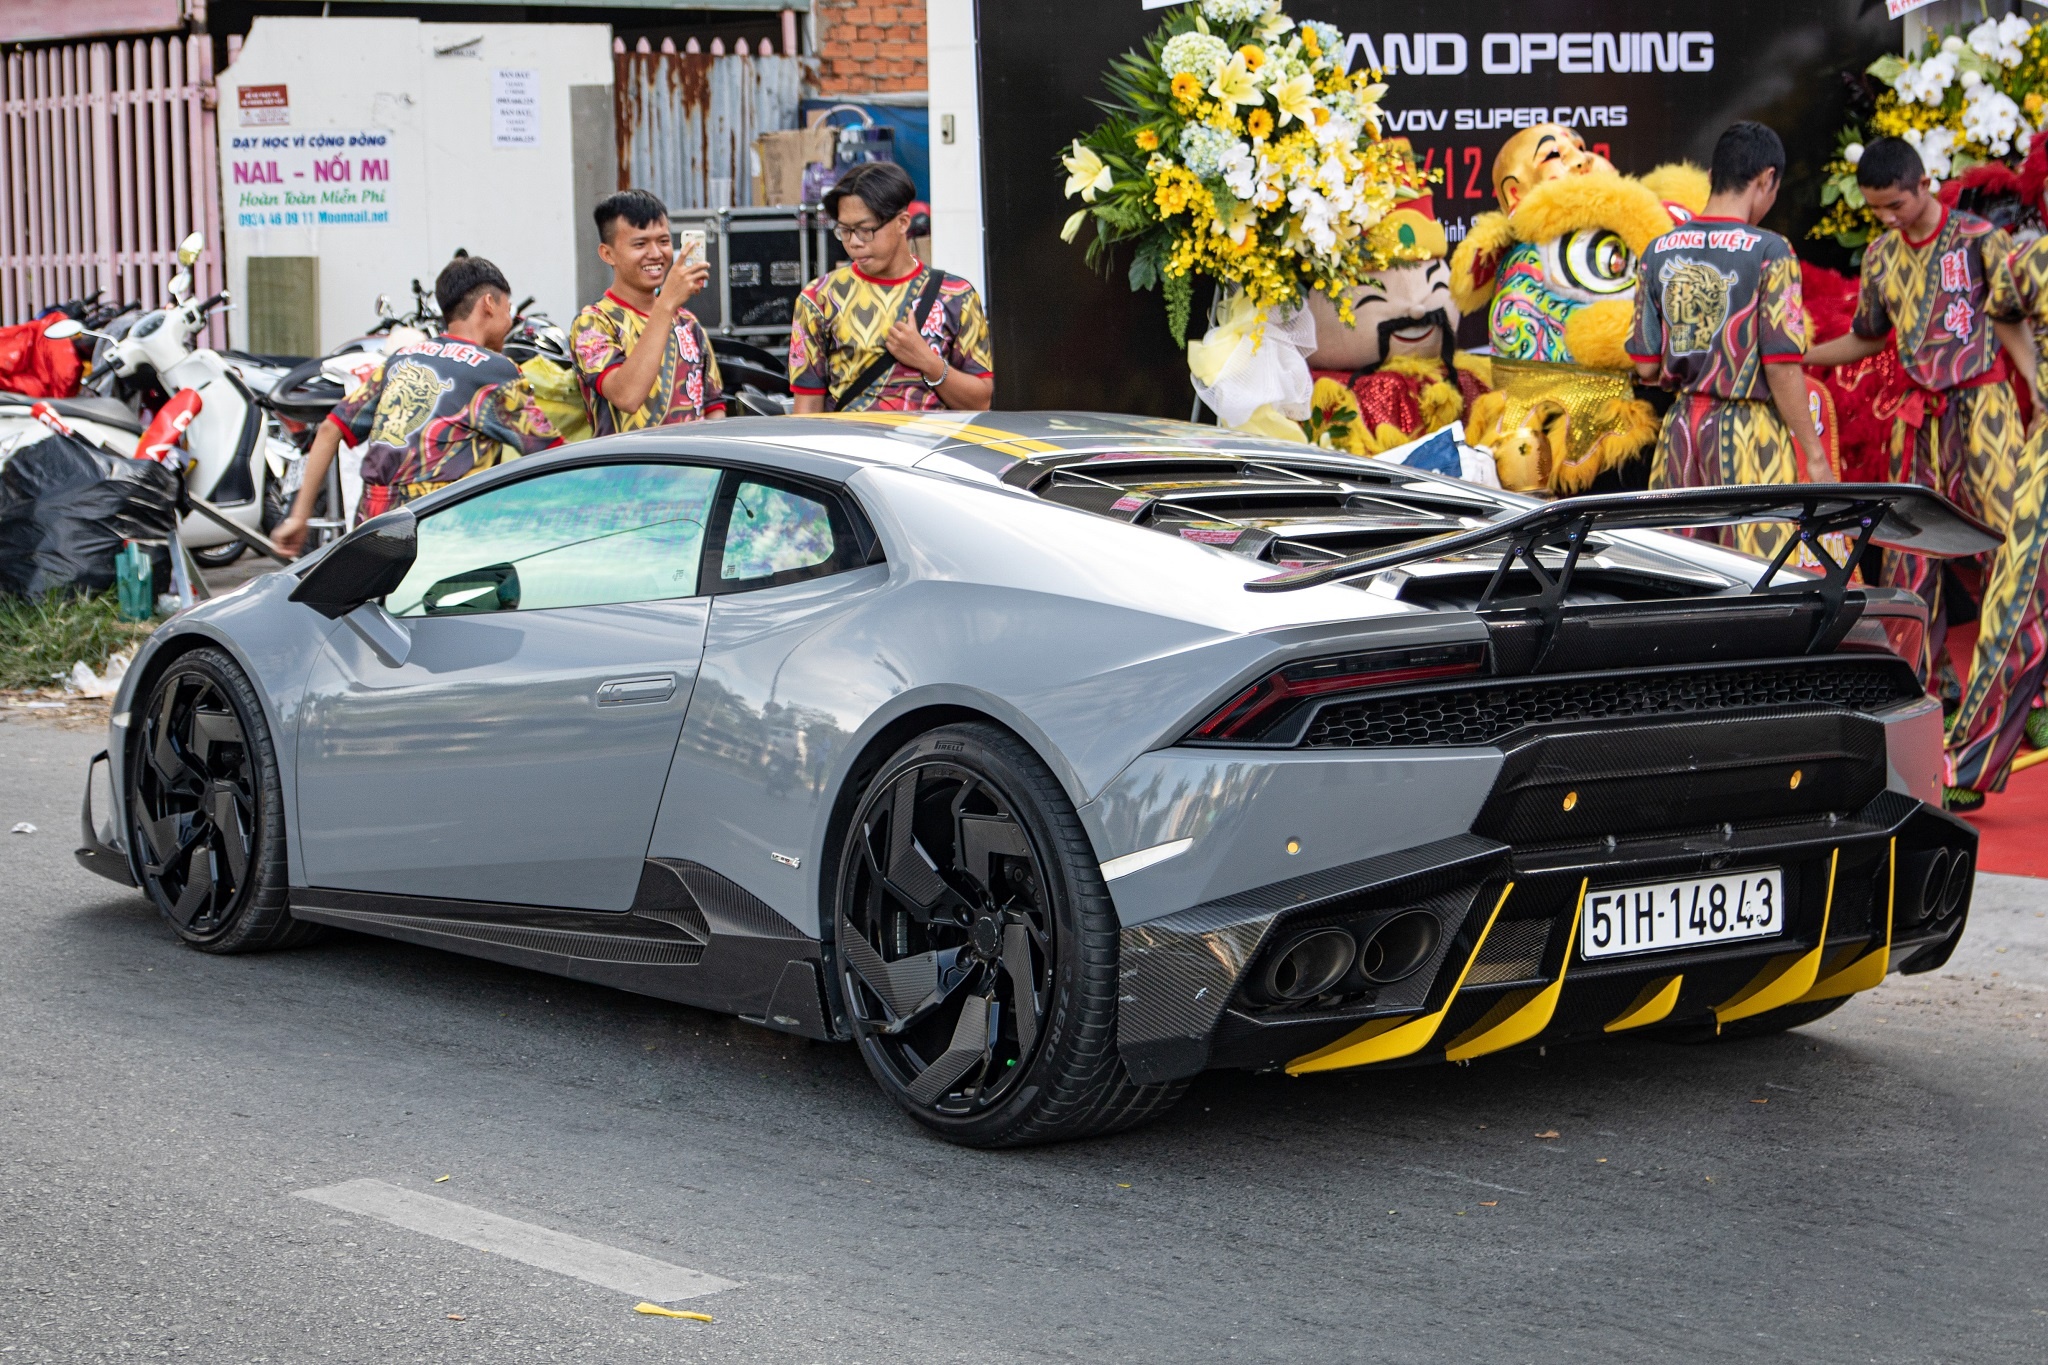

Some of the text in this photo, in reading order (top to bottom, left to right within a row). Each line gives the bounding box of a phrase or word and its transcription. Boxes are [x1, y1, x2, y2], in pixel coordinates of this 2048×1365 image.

[1481, 31, 1715, 74] OPENING
[1385, 105, 1628, 132] VOV SUPER CARS
[232, 137, 258, 151] DẠY
[262, 136, 289, 151] HỌC
[308, 134, 346, 150] CỘNG
[233, 161, 284, 184] NAIL
[313, 152, 350, 183] NỐI
[361, 159, 389, 181] MI
[239, 191, 279, 207] Hoàn
[284, 190, 317, 206] Toàn
[320, 187, 357, 204] Miễn
[286, 211, 299, 224] 09
[303, 211, 314, 224] 11
[318, 209, 389, 223] Moonnail.net
[1436, 216, 1467, 243] inh
[1655, 228, 1762, 253] LONG VIỆT
[439, 342, 491, 368] VIỆT
[934, 740, 966, 752] PIRELLI
[1591, 877, 1774, 949] 51H-148.43
[1044, 985, 1071, 1066] ZERO
